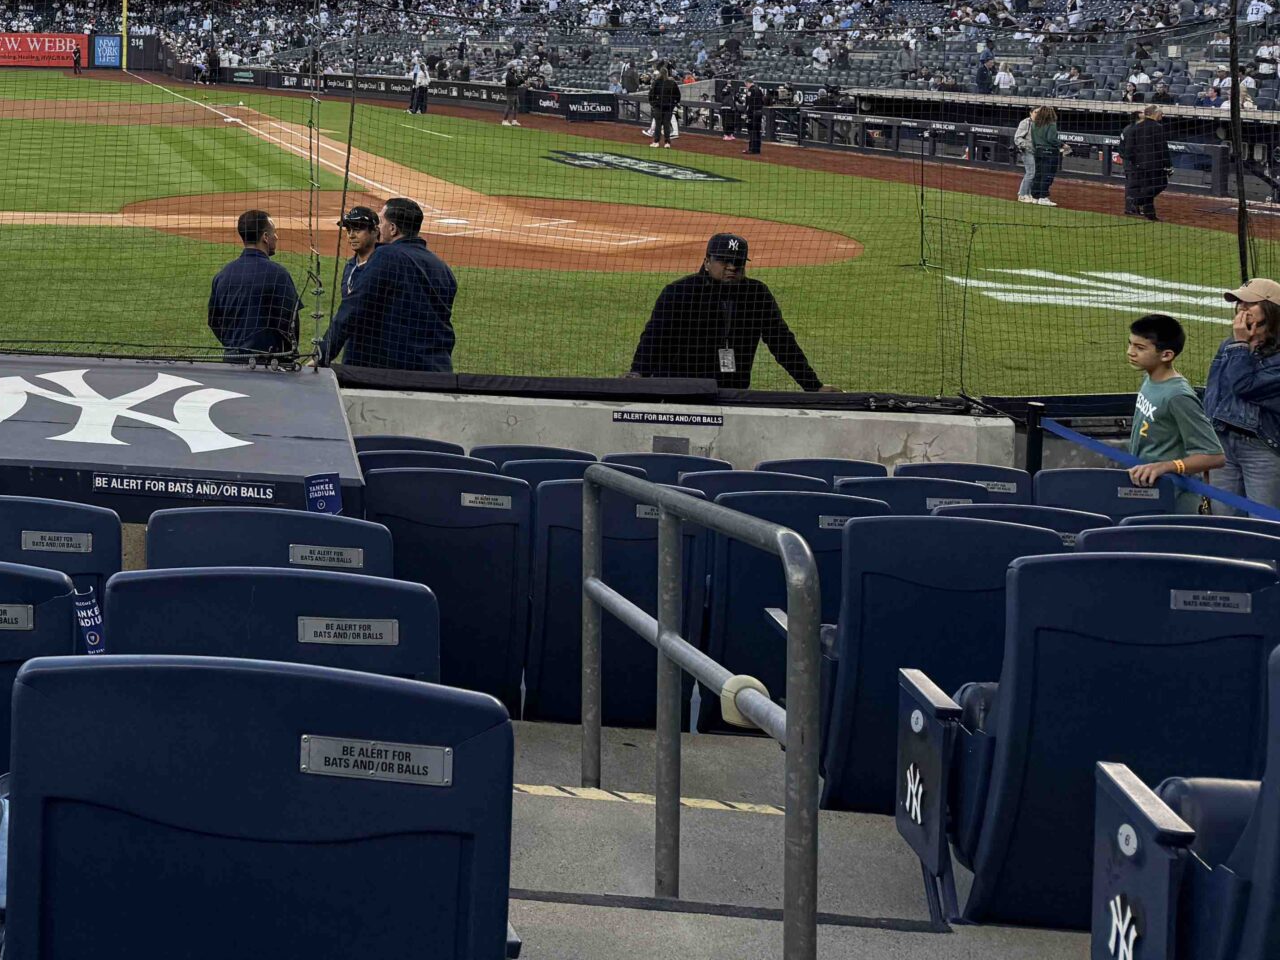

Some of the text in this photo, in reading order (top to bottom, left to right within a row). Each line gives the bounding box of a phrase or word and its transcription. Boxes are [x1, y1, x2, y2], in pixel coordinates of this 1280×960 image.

[1250, 7, 1260, 15] 13
[131, 38, 143, 46] 314
[97, 46, 118, 55] YORK
[729, 239, 739, 251] NY
[659, 414, 674, 422] BATS
[703, 416, 722, 424] BALLS
[96, 477, 272, 498] BE ALERT FOR BATS AND/OR BALLS
[309, 483, 334, 491] YANKEE
[309, 490, 335, 498] STADIUM
[77, 606, 100, 618] ANKE
[333, 632, 360, 640] AND/OR
[362, 632, 383, 640] BALLS
[342, 746, 411, 762] BE ALERT FOR
[324, 756, 429, 776] BATS AND/OR BALLS
[906, 763, 923, 825] NY
[1108, 894, 1139, 959] NY
